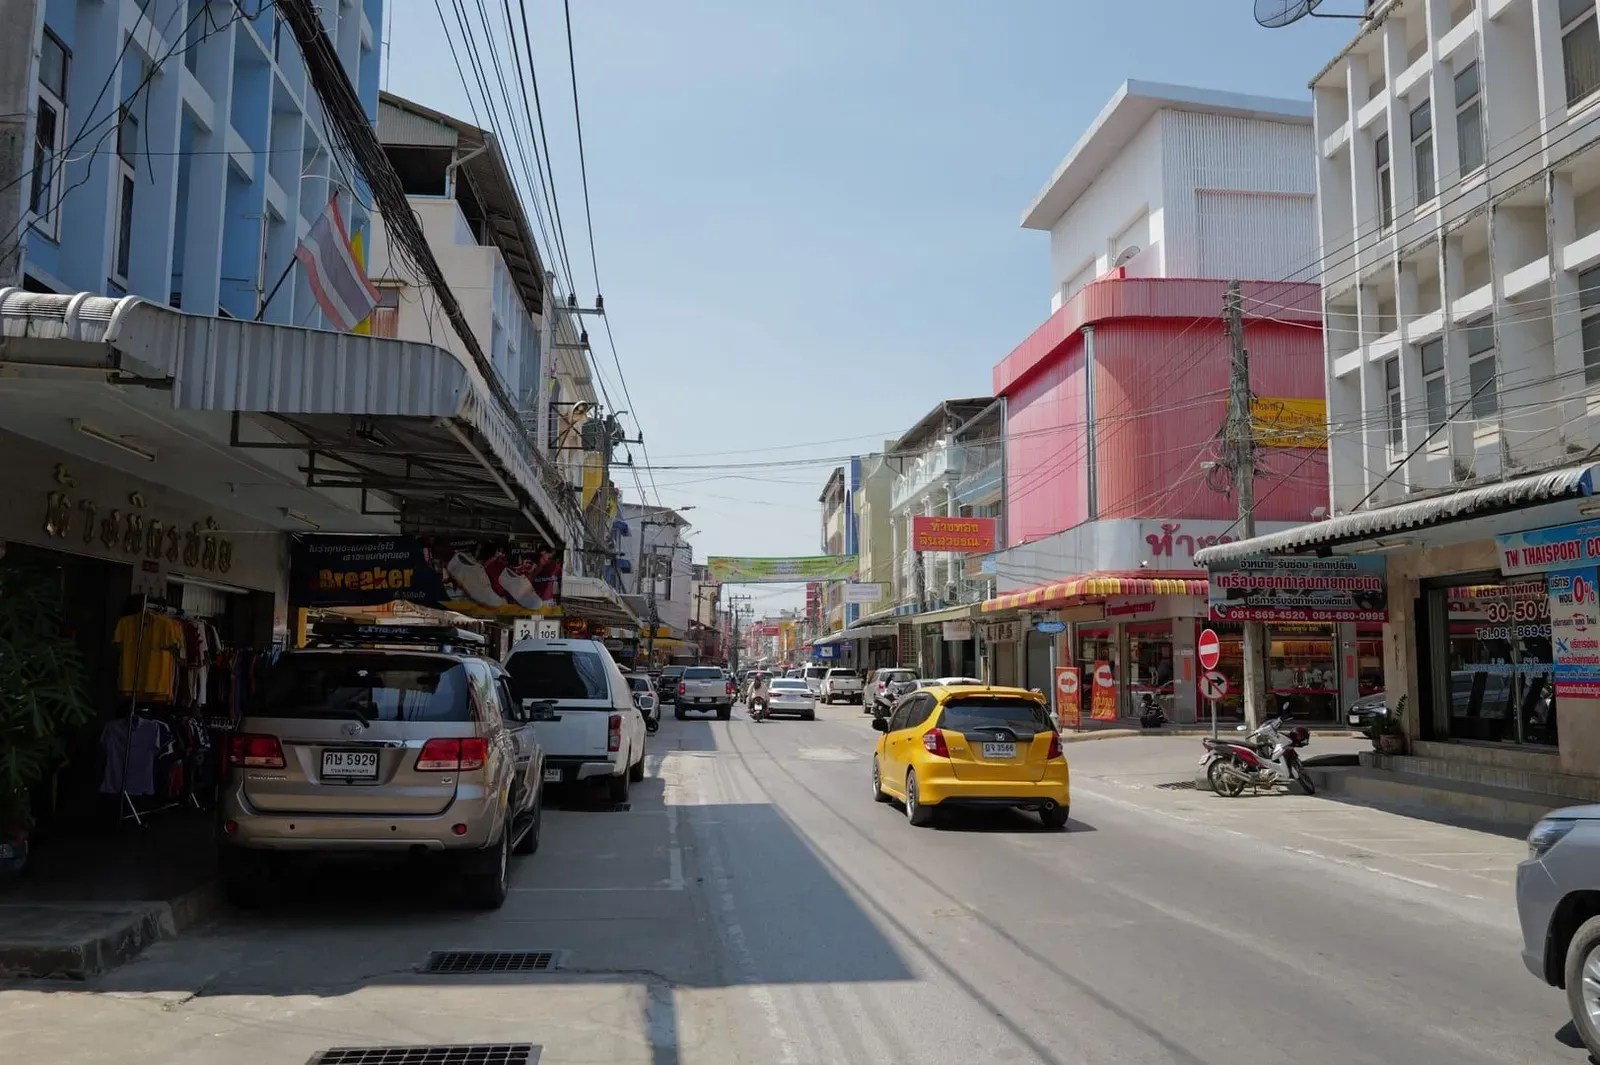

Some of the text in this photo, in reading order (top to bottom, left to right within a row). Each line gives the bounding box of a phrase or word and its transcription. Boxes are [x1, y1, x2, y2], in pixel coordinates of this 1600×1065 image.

[983, 536, 991, 547] 7
[1505, 550, 1519, 568] TW
[1522, 540, 1582, 565] THAISPORT
[319, 566, 414, 590] Breaker
[1217, 570, 1381, 592] เครื่องออกกำลังกายทุกชนิด
[1551, 575, 1569, 588] บริการ
[1574, 577, 1595, 603] 0%
[540, 631, 556, 639] 105
[985, 623, 1013, 641] LIPS
[346, 753, 377, 766] 5929
